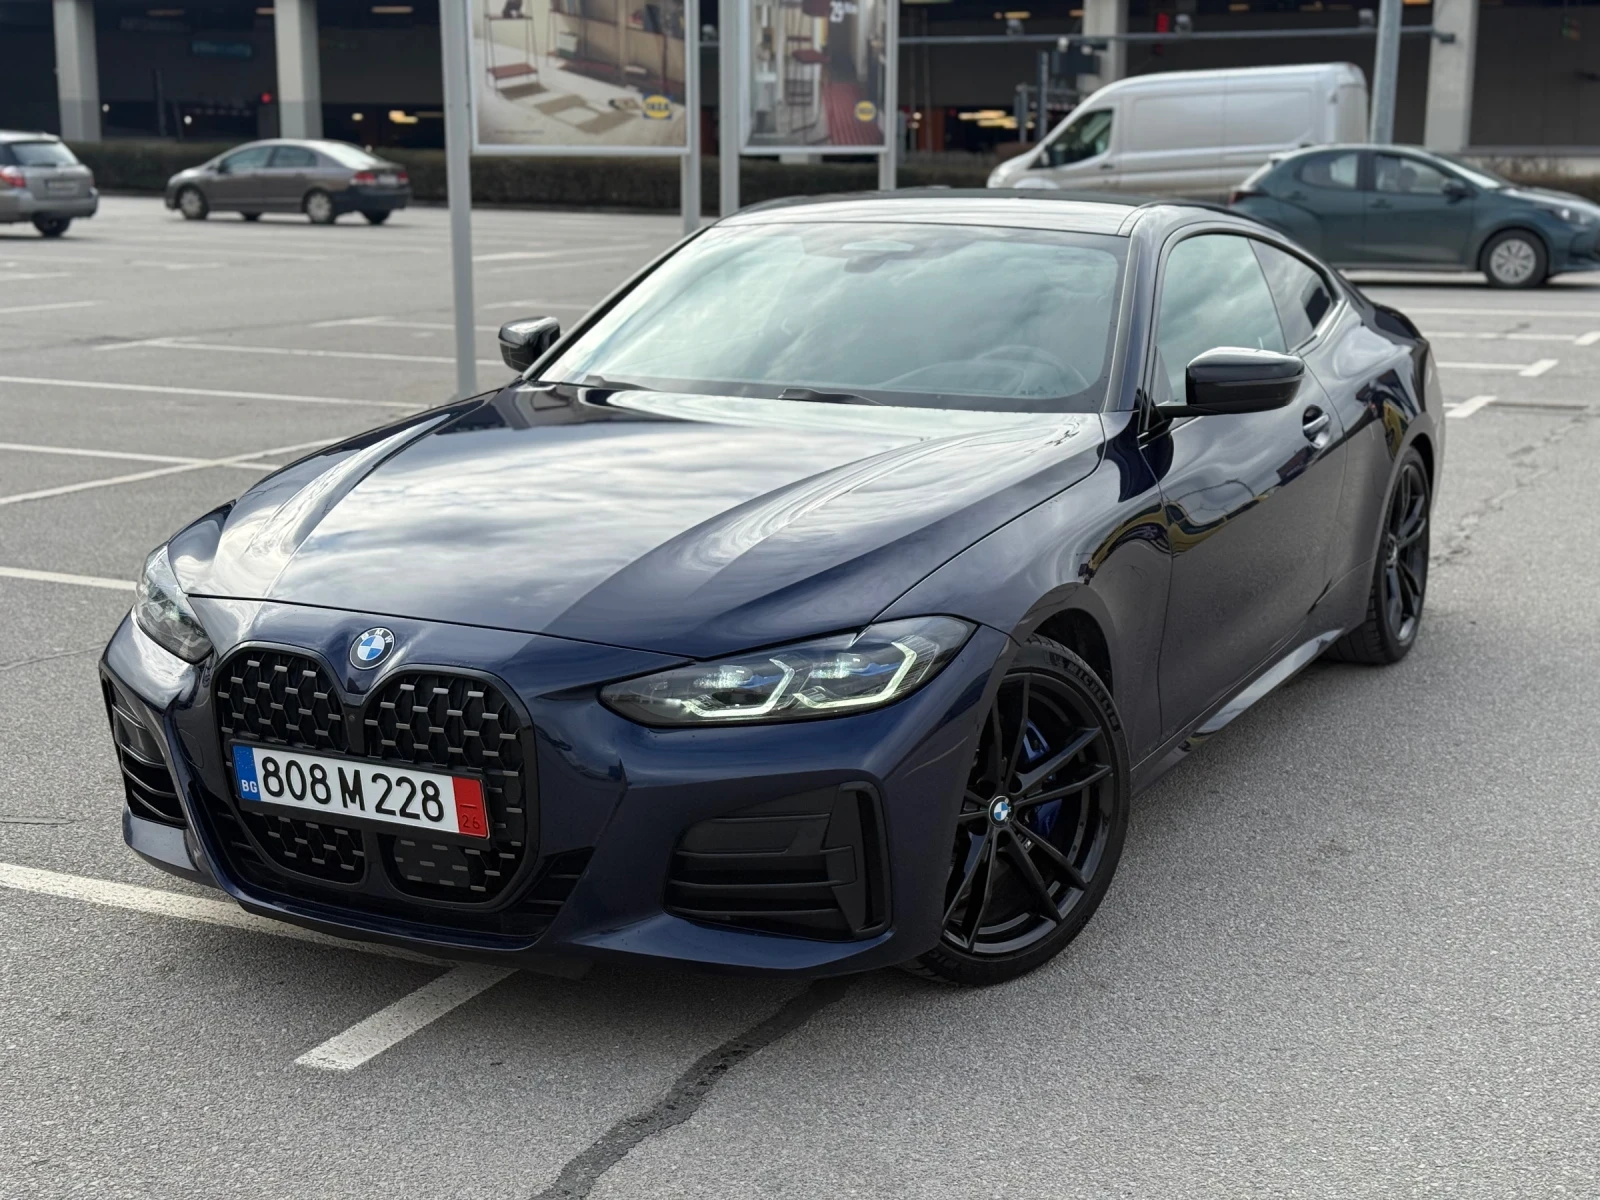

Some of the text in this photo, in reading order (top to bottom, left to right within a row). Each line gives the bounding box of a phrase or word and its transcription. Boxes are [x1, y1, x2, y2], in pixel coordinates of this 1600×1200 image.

[241, 779, 258, 793] BG
[262, 756, 445, 822] 808 M 228
[461, 814, 481, 830] 26
